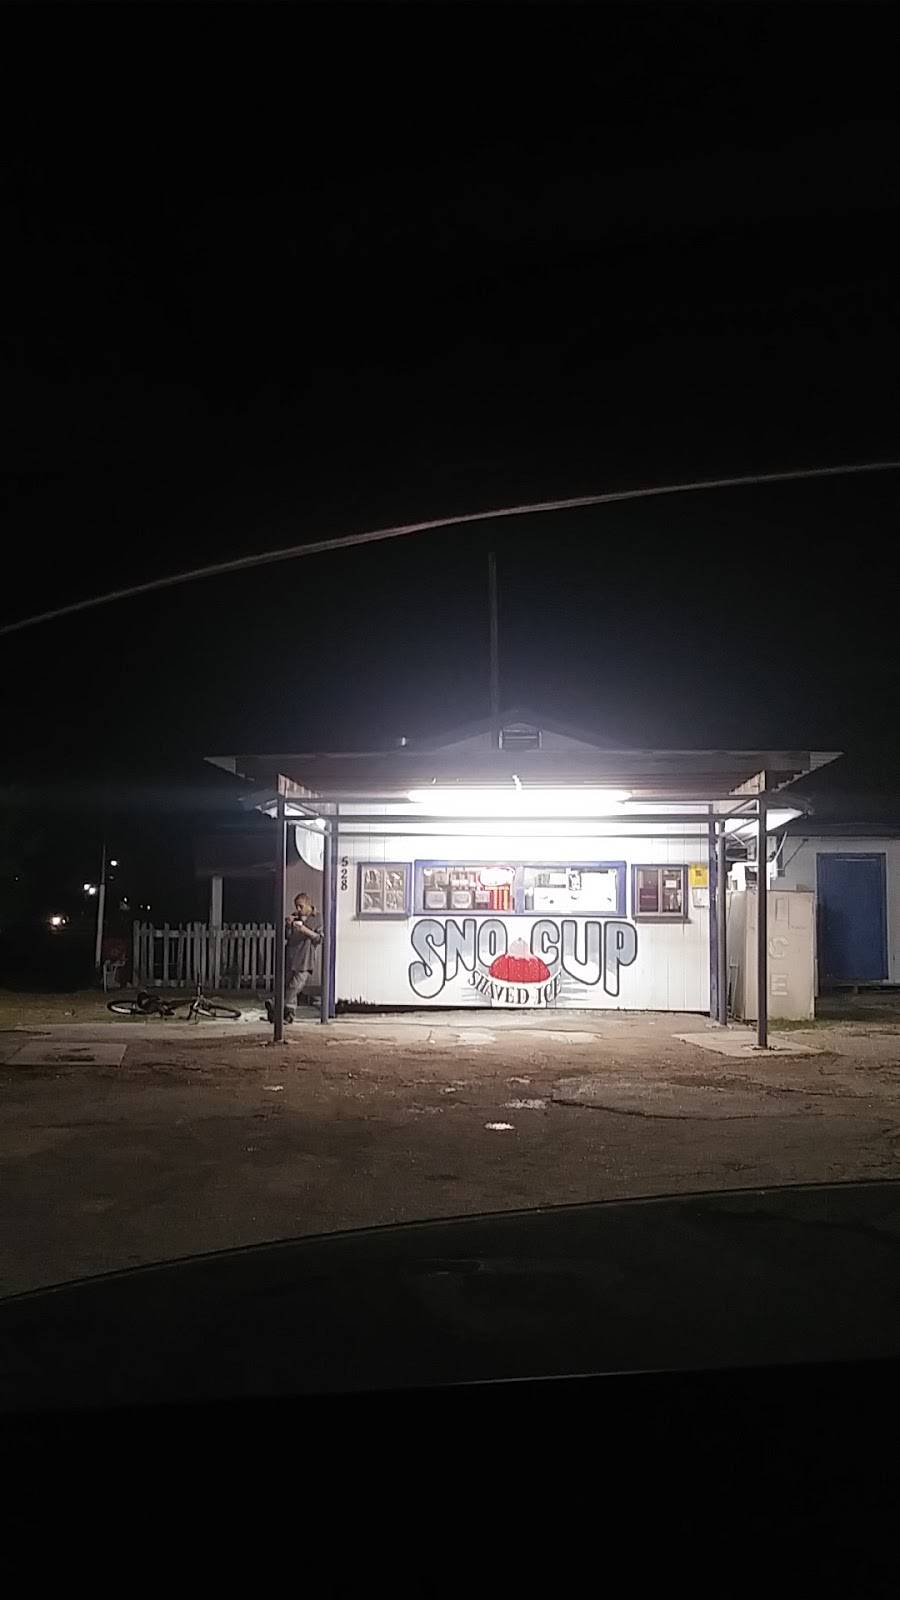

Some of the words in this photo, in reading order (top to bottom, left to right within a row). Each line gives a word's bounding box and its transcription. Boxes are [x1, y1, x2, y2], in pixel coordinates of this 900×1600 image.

[340, 856, 350, 891] 528
[408, 918, 508, 999] SNO
[530, 919, 638, 997] CUP
[467, 970, 530, 1004] SHAVED
[537, 974, 562, 1004] ICE
